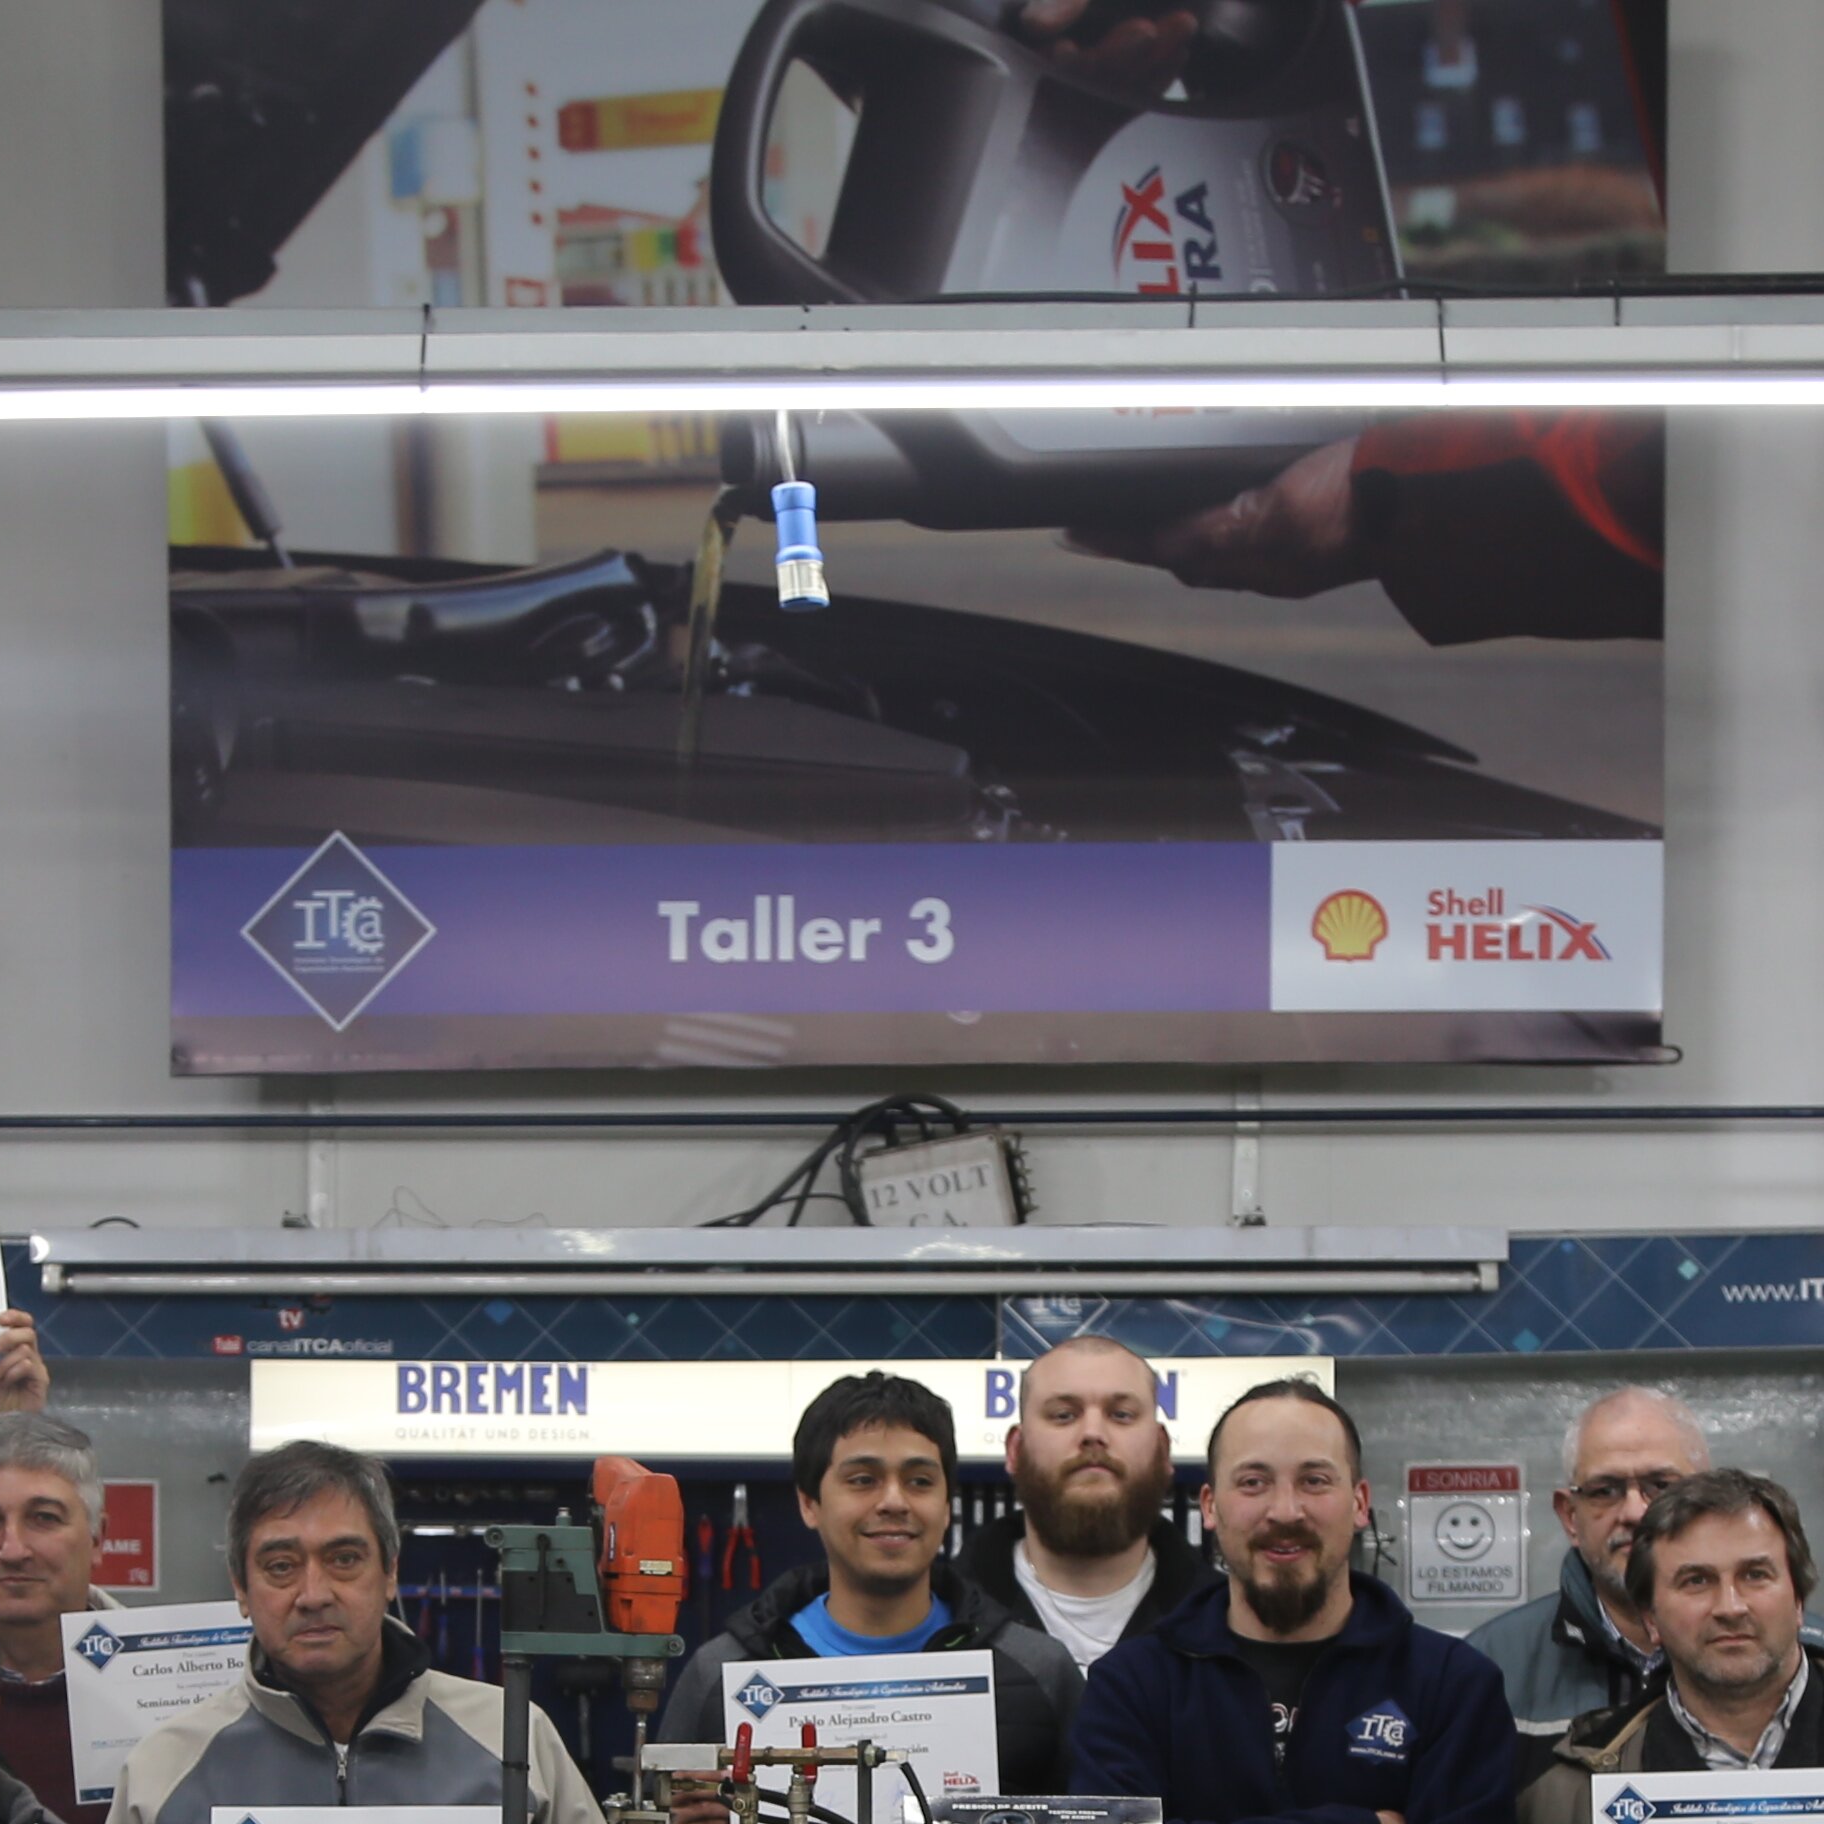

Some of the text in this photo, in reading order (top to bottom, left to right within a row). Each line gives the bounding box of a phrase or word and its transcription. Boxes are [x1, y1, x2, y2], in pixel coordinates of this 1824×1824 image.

[1117, 167, 1180, 294] LIX
[1428, 889, 1503, 915] Shell
[660, 898, 955, 962] Taller 3
[1426, 920, 1611, 960] HELIX
[870, 1164, 990, 1208] 12 VOLT
[397, 1364, 588, 1415] BREMEN
[486, 1429, 519, 1440] UND
[1427, 1472, 1500, 1487] SONRIA
[1418, 1566, 1512, 1578] LO ESTAMOS
[1428, 1581, 1503, 1592] FILMANDO
[132, 1665, 173, 1677] Carlos
[177, 1660, 222, 1673] Alberto
[137, 1696, 191, 1709] Seminario
[828, 1713, 888, 1728] Alejandro
[891, 1711, 932, 1723] Castro
[944, 1777, 978, 1786] HELIX
